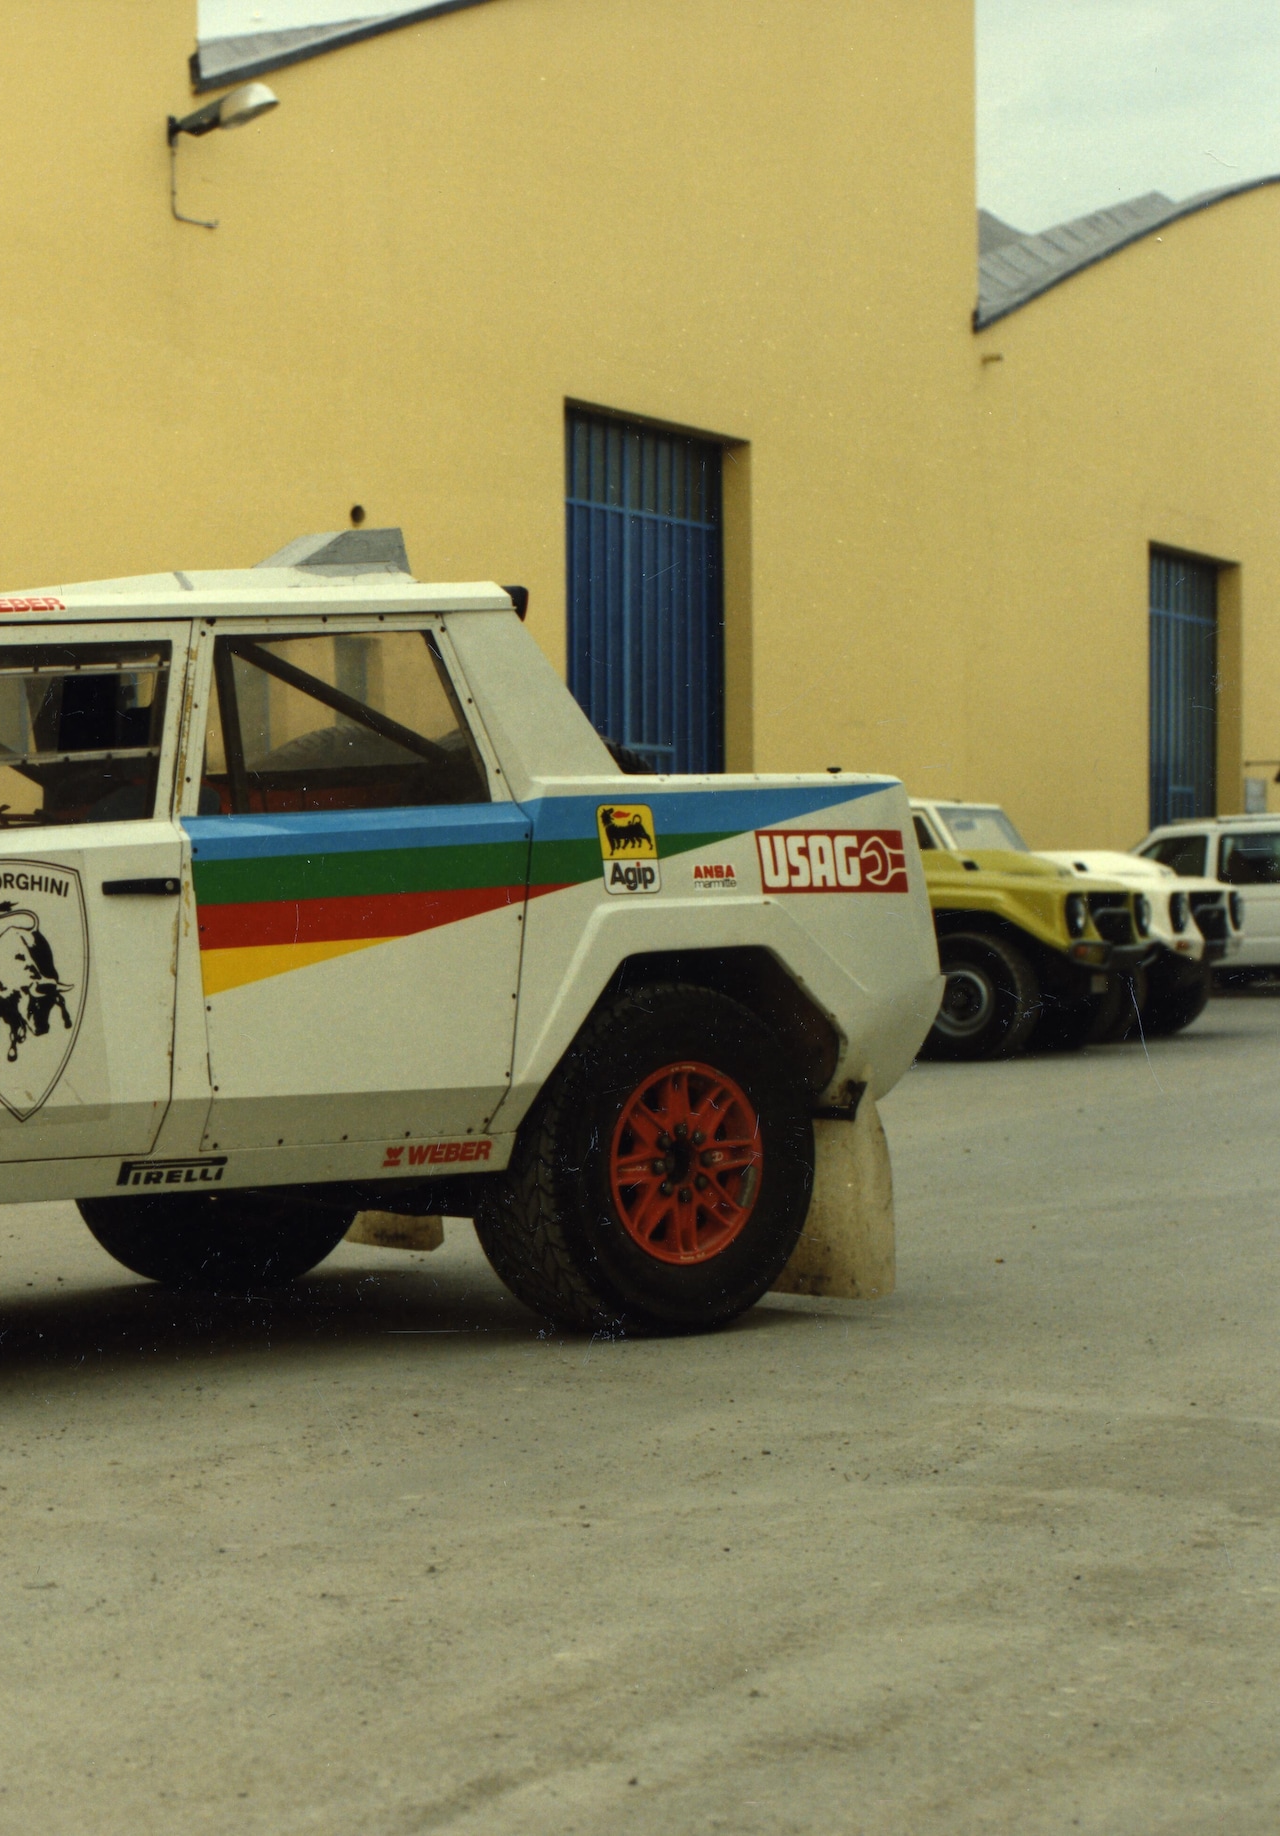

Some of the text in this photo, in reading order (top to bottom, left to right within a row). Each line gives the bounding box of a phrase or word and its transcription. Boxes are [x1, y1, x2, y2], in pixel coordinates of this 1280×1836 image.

[610, 861, 655, 890] Agip
[693, 864, 736, 879] ANSA
[758, 835, 862, 888] USAG
[408, 1140, 493, 1166] WEBER
[116, 1156, 228, 1186] PIRELLI
